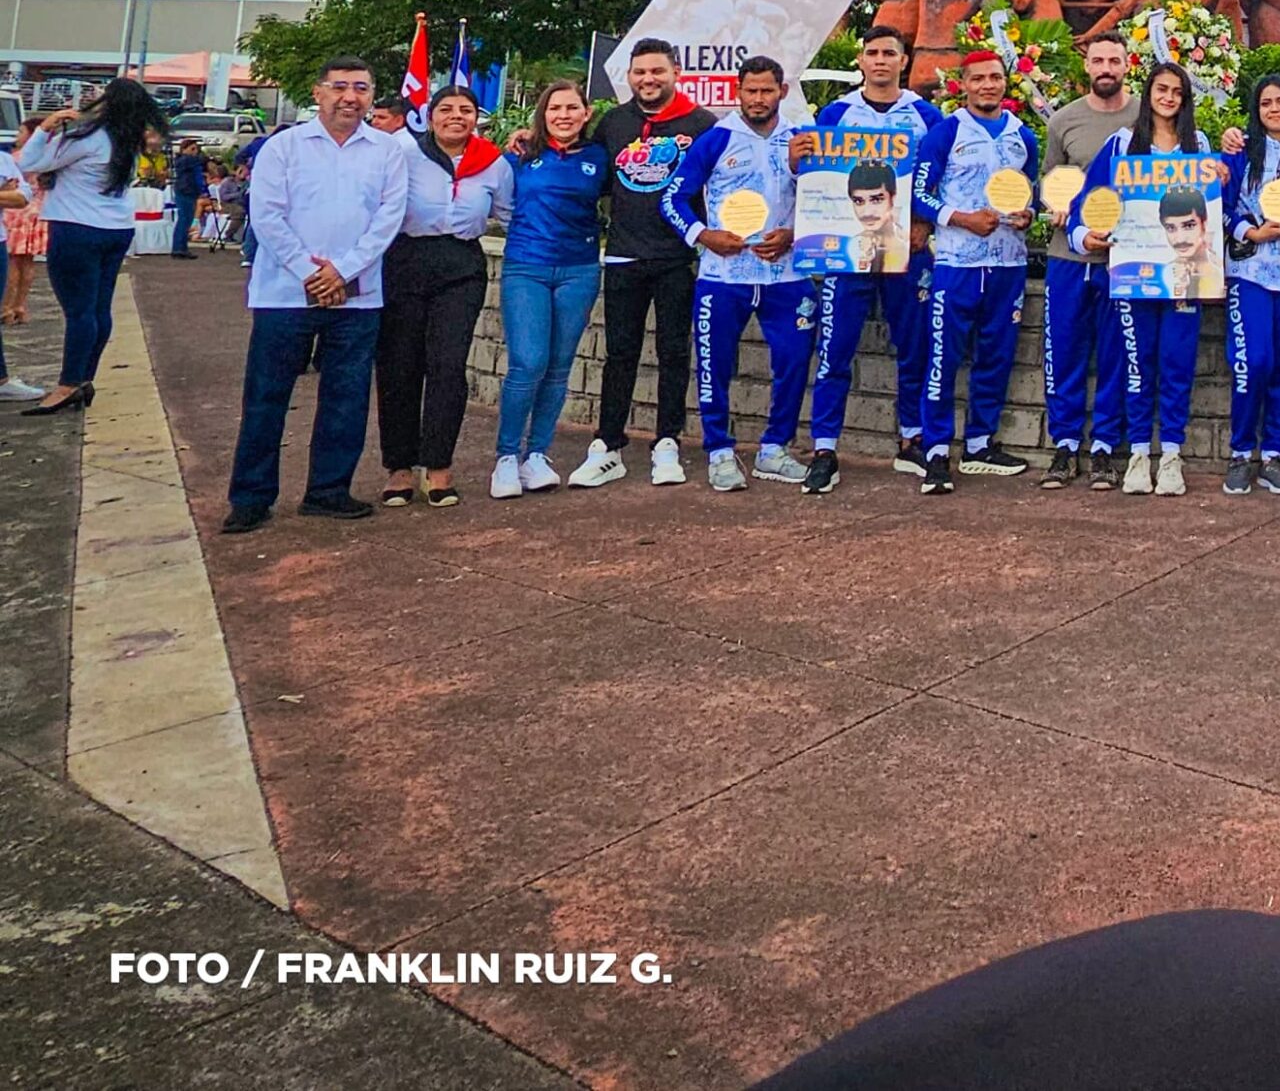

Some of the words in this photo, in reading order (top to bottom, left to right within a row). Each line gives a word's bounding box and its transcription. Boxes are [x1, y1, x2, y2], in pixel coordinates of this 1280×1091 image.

[672, 45, 748, 71] ALEXIS
[674, 76, 742, 106] GÜEL
[808, 131, 909, 160] ALEXIS
[1114, 159, 1217, 187] ALEXIS
[700, 294, 714, 403] NICARAGUA
[927, 290, 946, 401] NICARAGUA
[1121, 298, 1141, 394] NICARAGU
[1229, 283, 1248, 394] NICARAGUA
